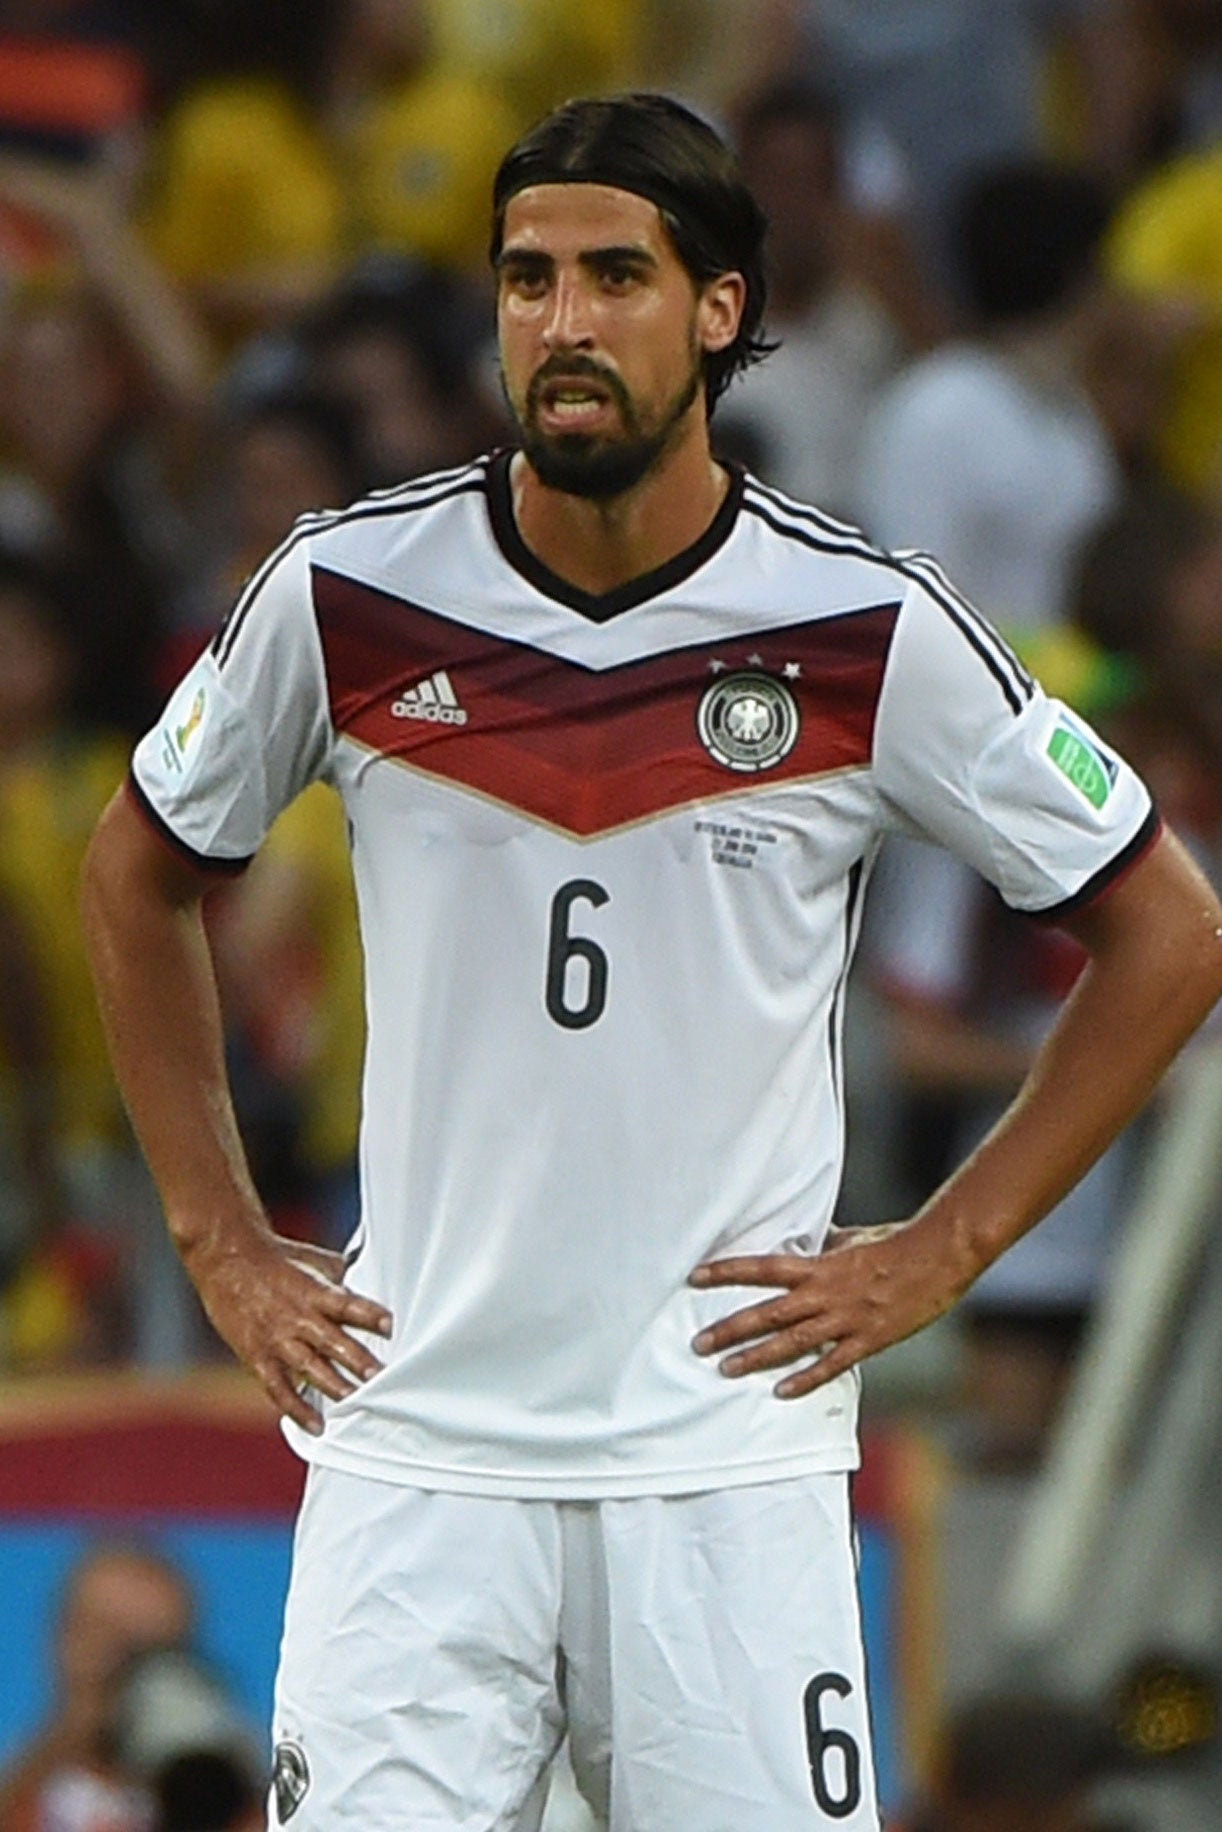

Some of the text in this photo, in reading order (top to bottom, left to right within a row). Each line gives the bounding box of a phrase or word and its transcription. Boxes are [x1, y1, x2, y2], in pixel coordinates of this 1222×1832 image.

[391, 700, 468, 726] adidas
[545, 878, 611, 1030] 6
[803, 1672, 861, 1819] 6
